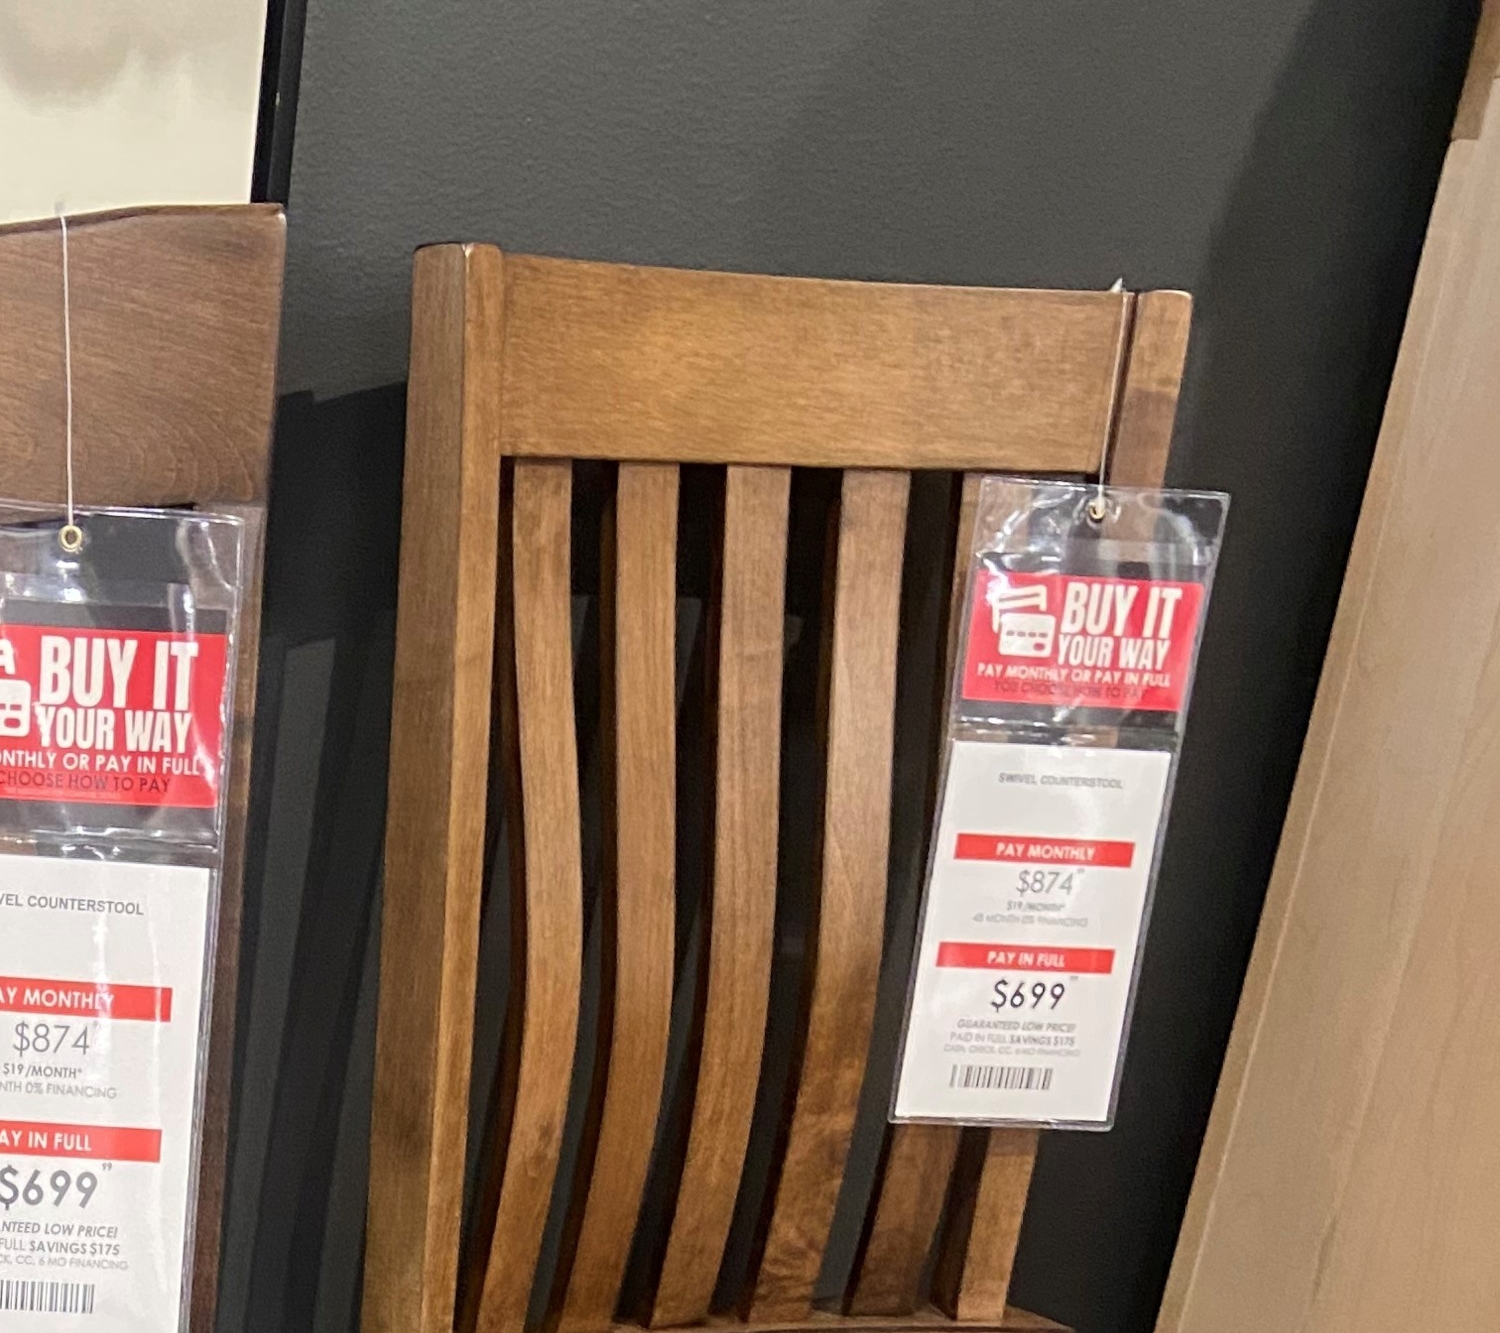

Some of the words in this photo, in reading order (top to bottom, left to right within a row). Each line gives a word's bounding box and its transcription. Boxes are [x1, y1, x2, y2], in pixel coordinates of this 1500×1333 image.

[1060, 582, 1138, 637] BUY
[1142, 586, 1182, 639] IT
[1057, 634, 1114, 668] YOUR
[1119, 638, 1171, 670] WAY
[40, 635, 137, 709] BUY
[153, 641, 198, 711] IT
[977, 662, 1003, 677] PAY
[1005, 665, 1069, 682] MONTHLY
[1071, 669, 1091, 682] OR
[1094, 670, 1121, 684] PAY
[1124, 672, 1139, 686] IN
[1142, 673, 1171, 687] FULL
[38, 706, 115, 751] YOUR
[124, 712, 192, 754] WAY
[63, 753, 90, 771] OR
[95, 754, 132, 773] PAY
[137, 756, 156, 774] IN
[162, 757, 200, 776] FULL
[69, 774, 108, 791] HOW
[113, 776, 133, 792] TO
[139, 777, 171, 793] PAY
[995, 842, 1025, 857] PAY
[1027, 843, 1096, 861] MONTHLY
[1016, 869, 1074, 897] $874
[27, 895, 145, 915] COUNTERSTOOL
[987, 950, 1016, 964] PAY
[1018, 952, 1035, 966] IN
[1037, 953, 1066, 967] FULL
[23, 988, 115, 1011] MONTHLY
[991, 978, 1065, 1013] $699
[13, 1021, 90, 1057] $874
[25, 1082, 43, 1095] 0%
[46, 1084, 118, 1099] FINANCING
[28, 1130, 48, 1149] IN
[53, 1132, 92, 1151] FULL
[44, 1222, 74, 1236] LOW
[77, 1225, 118, 1239] PRICE!
[29, 1241, 86, 1255] SAVINGS
[89, 1243, 121, 1257] $175
[48, 1257, 67, 1267] MO
[69, 1258, 129, 1270] FINANCING
